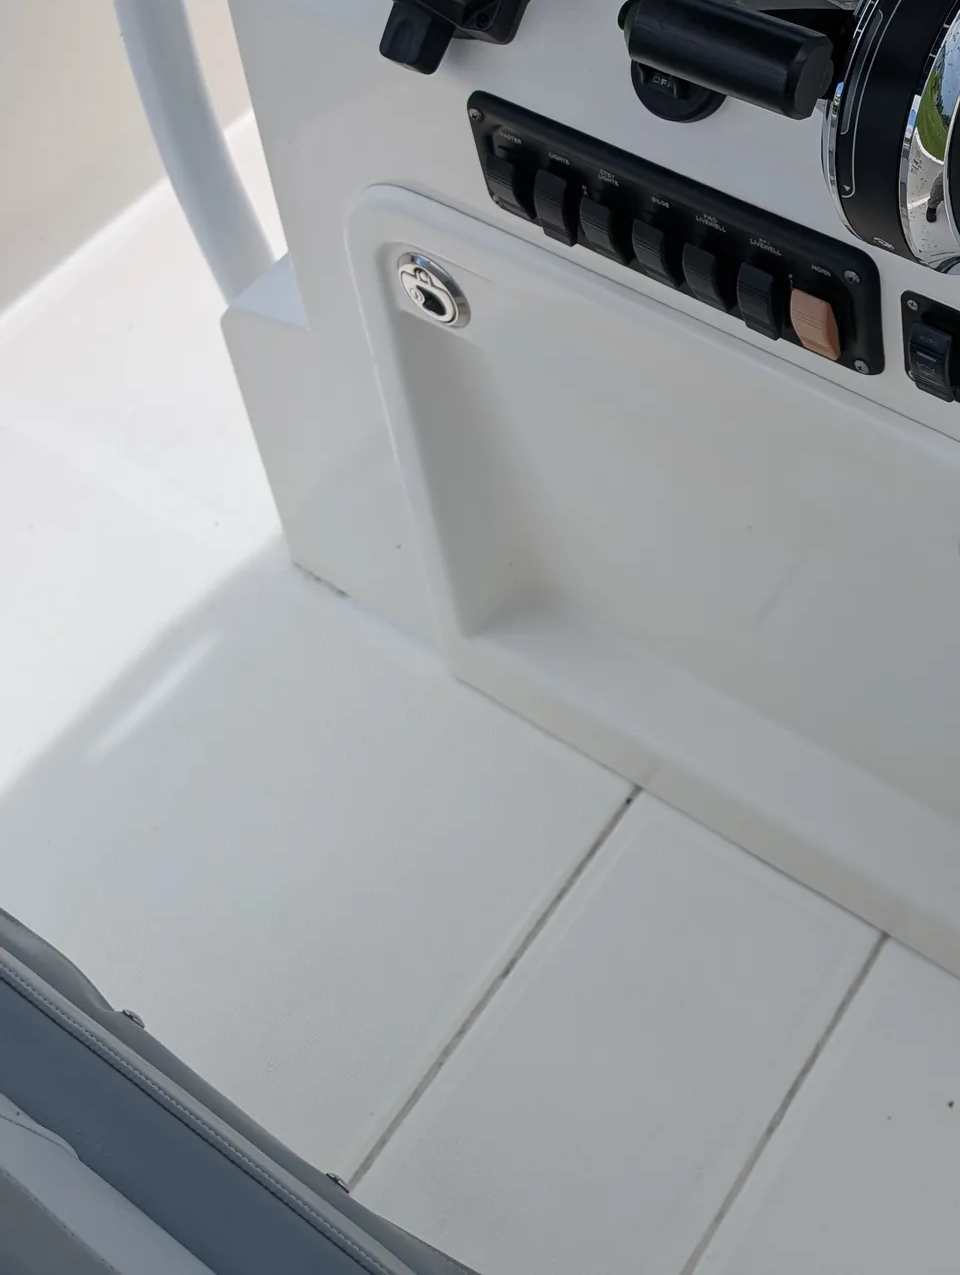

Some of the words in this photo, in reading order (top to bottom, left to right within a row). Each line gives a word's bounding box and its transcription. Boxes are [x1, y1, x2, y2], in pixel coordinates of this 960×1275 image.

[548, 152, 570, 166] LIGHTS
[597, 174, 619, 187] LIGHTS
[695, 215, 727, 233] LIVEWELL
[750, 238, 782, 256] LIVEWELL
[811, 264, 832, 277] HORN
[919, 334, 939, 347] AUTO
